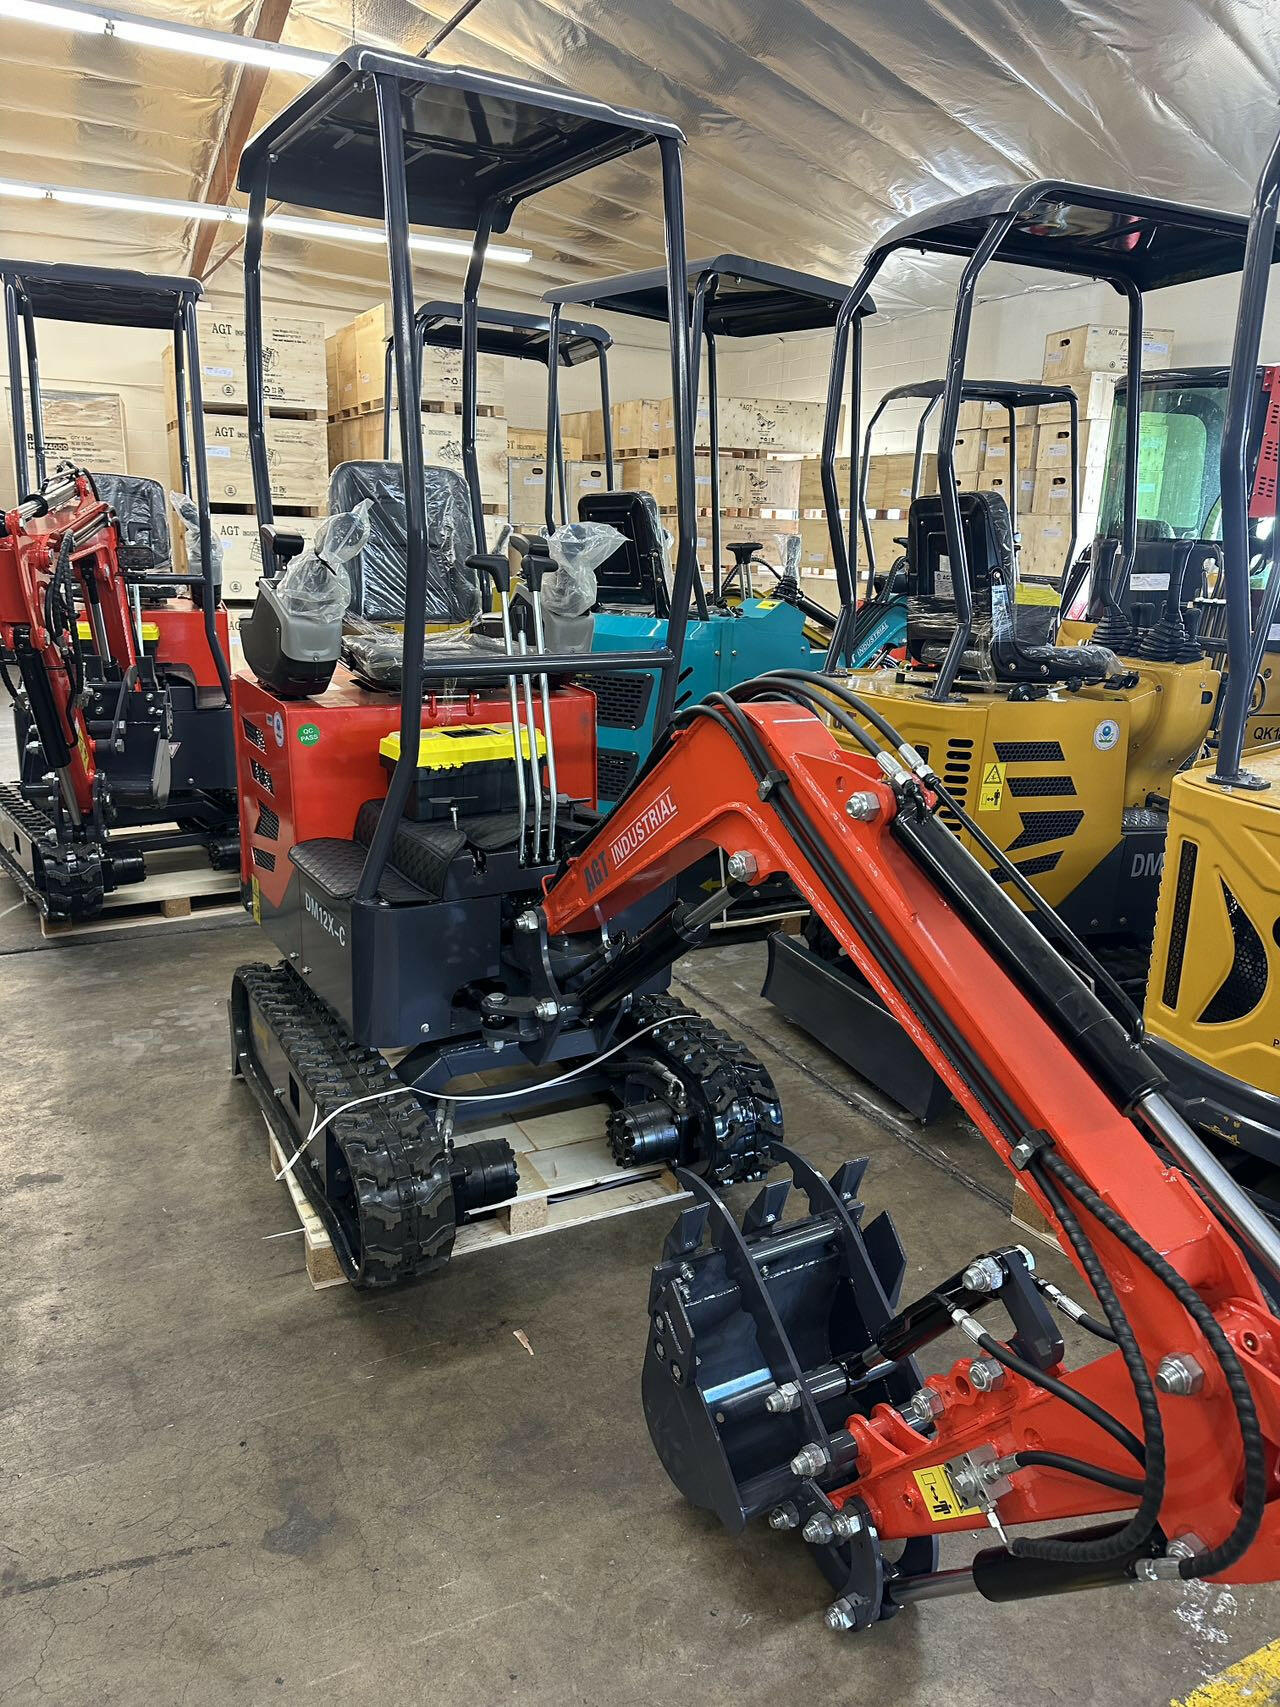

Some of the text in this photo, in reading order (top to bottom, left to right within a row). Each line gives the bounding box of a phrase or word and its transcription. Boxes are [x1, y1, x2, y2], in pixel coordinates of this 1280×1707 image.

[211, 323, 233, 335] AGT
[214, 427, 235, 437] AGT
[220, 525, 240, 536] AGT
[857, 621, 889, 656] INDUSTRIAL
[302, 727, 314, 735] QC
[300, 733, 319, 742] PASS
[584, 794, 677, 895] AGT INDUSTRIAL
[304, 891, 346, 947] DM12X-C
